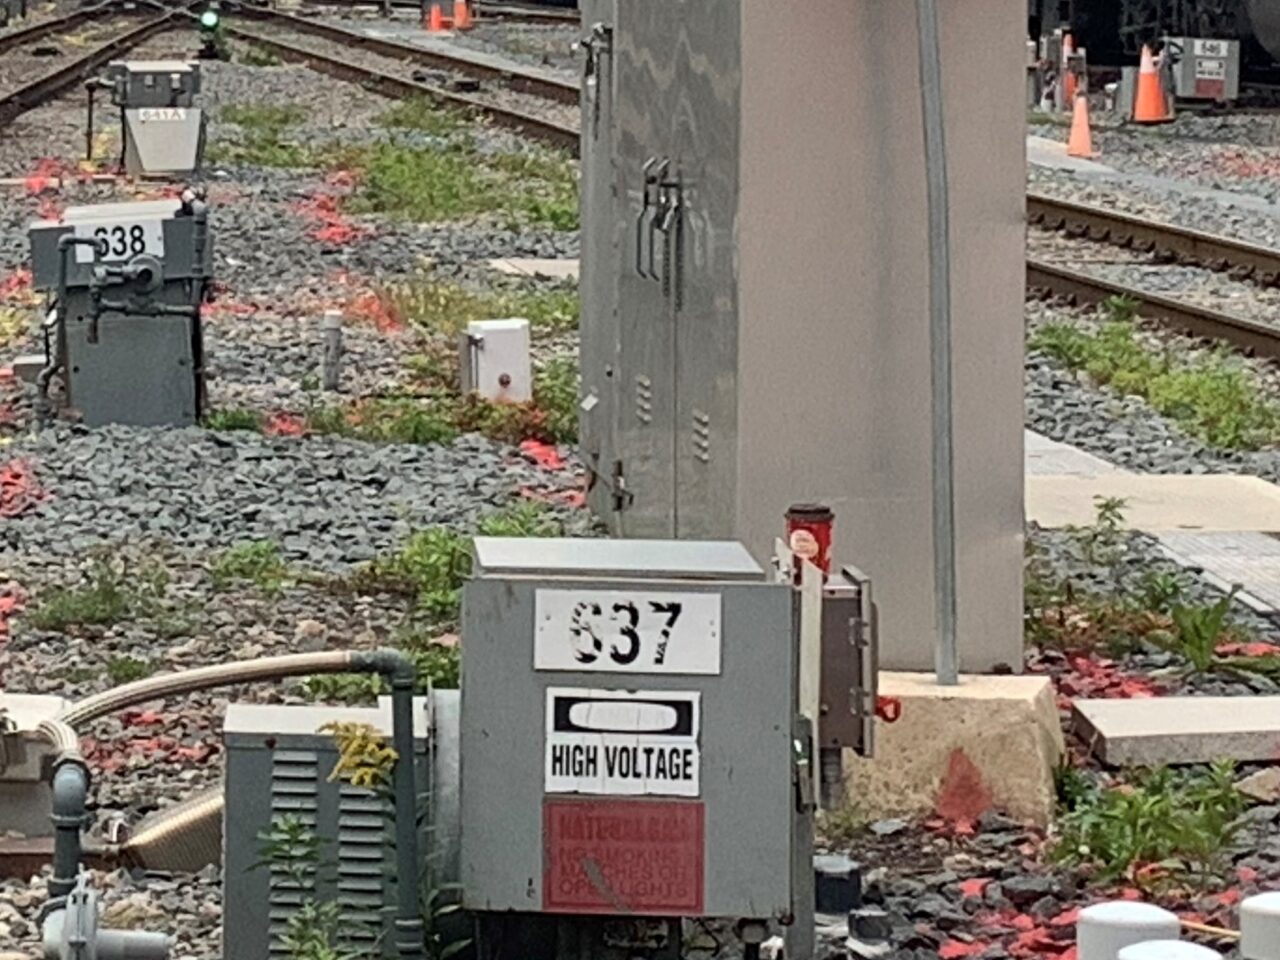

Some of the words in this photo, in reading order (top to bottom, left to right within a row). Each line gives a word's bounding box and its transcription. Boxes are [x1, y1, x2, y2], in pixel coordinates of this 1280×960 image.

[94, 224, 146, 258] 638
[570, 601, 683, 665] 637
[552, 744, 598, 777] HIGH
[605, 746, 693, 781] VOLTAGE
